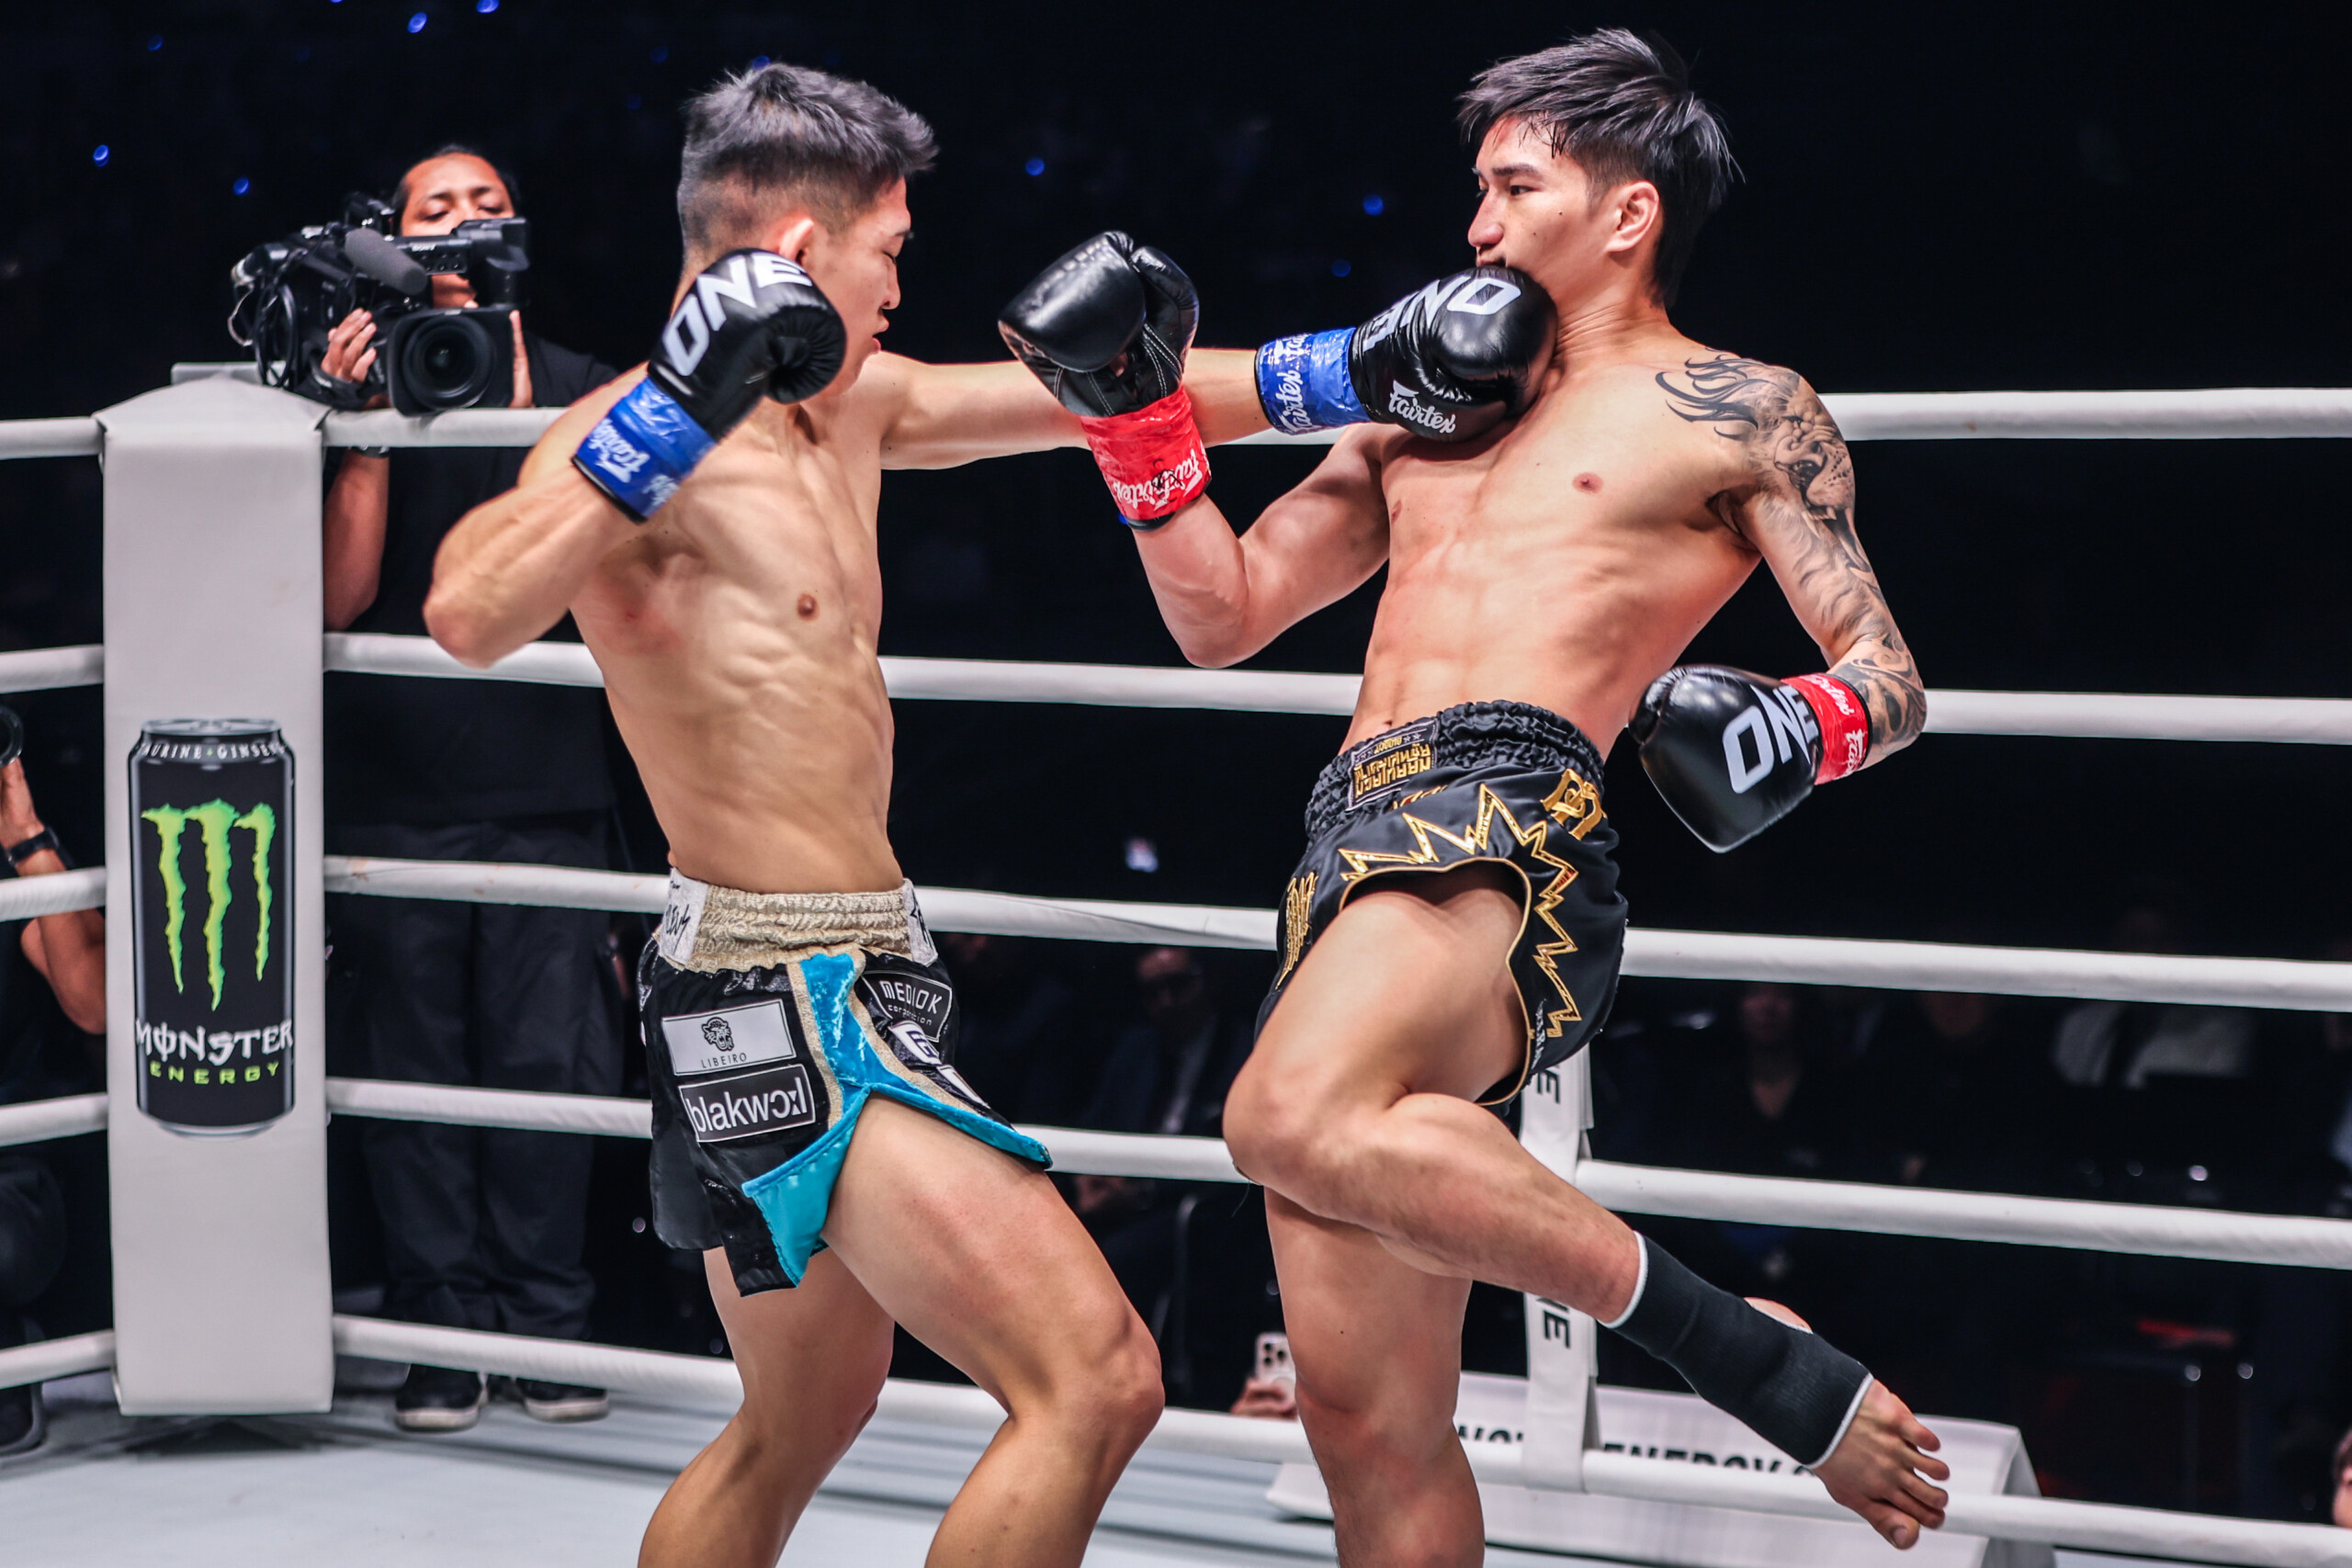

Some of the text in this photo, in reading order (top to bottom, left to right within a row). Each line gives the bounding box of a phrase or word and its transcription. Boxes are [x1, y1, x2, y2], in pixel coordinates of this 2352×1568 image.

[662, 252, 813, 378] ONE
[1363, 275, 1521, 353] ONE
[1388, 380, 1457, 434] Fairtex
[1722, 684, 1819, 795] ONE
[879, 980, 943, 1014] MEDIOK
[136, 1019, 293, 1066] MONSTER
[700, 1053, 747, 1068] LIBEIRO
[149, 1060, 279, 1085] ENERGY
